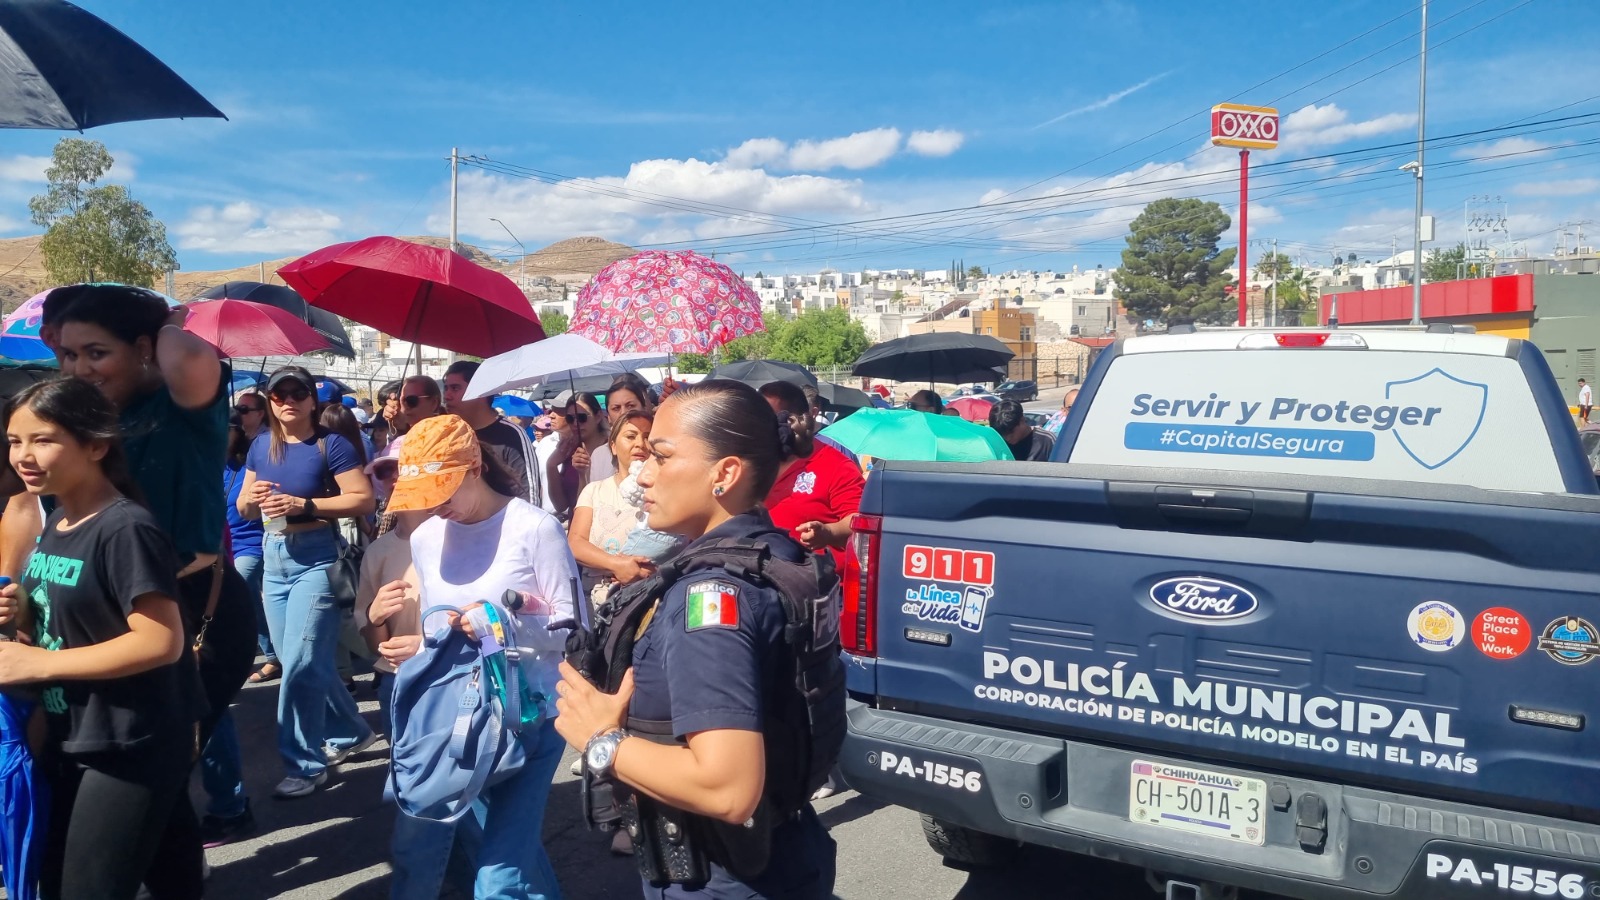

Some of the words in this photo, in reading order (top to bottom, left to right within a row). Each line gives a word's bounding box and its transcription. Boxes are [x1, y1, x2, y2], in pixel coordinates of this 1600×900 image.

[1221, 113, 1276, 139] OXXO
[1130, 393, 1231, 418] Servir
[1235, 402, 1262, 425] y
[1269, 398, 1442, 431] Proteger
[1160, 429, 1344, 454] #CapitalSegura
[910, 552, 984, 579] 911
[920, 586, 960, 604] Línea
[1167, 582, 1238, 613] Ford
[919, 603, 960, 622] Vida
[1482, 612, 1519, 625] Great
[1481, 632, 1496, 642] To
[1483, 622, 1519, 635] Place
[983, 652, 1160, 704] POLICÍA
[1173, 677, 1466, 748] MUNICIPAL
[974, 684, 1113, 718] CORPORACIÓN
[1117, 705, 1146, 724] DE
[1150, 710, 1236, 738] POLICÍA
[1241, 725, 1340, 753] MODELO
[1345, 740, 1378, 759] EN
[1384, 746, 1414, 765] EL
[1420, 750, 1479, 774] PAÍS
[880, 752, 982, 792] PA-1556
[1162, 767, 1232, 787] CHIHUAHUA
[1136, 779, 1260, 823] CH-501A-3
[1426, 853, 1584, 899] PA-1556
